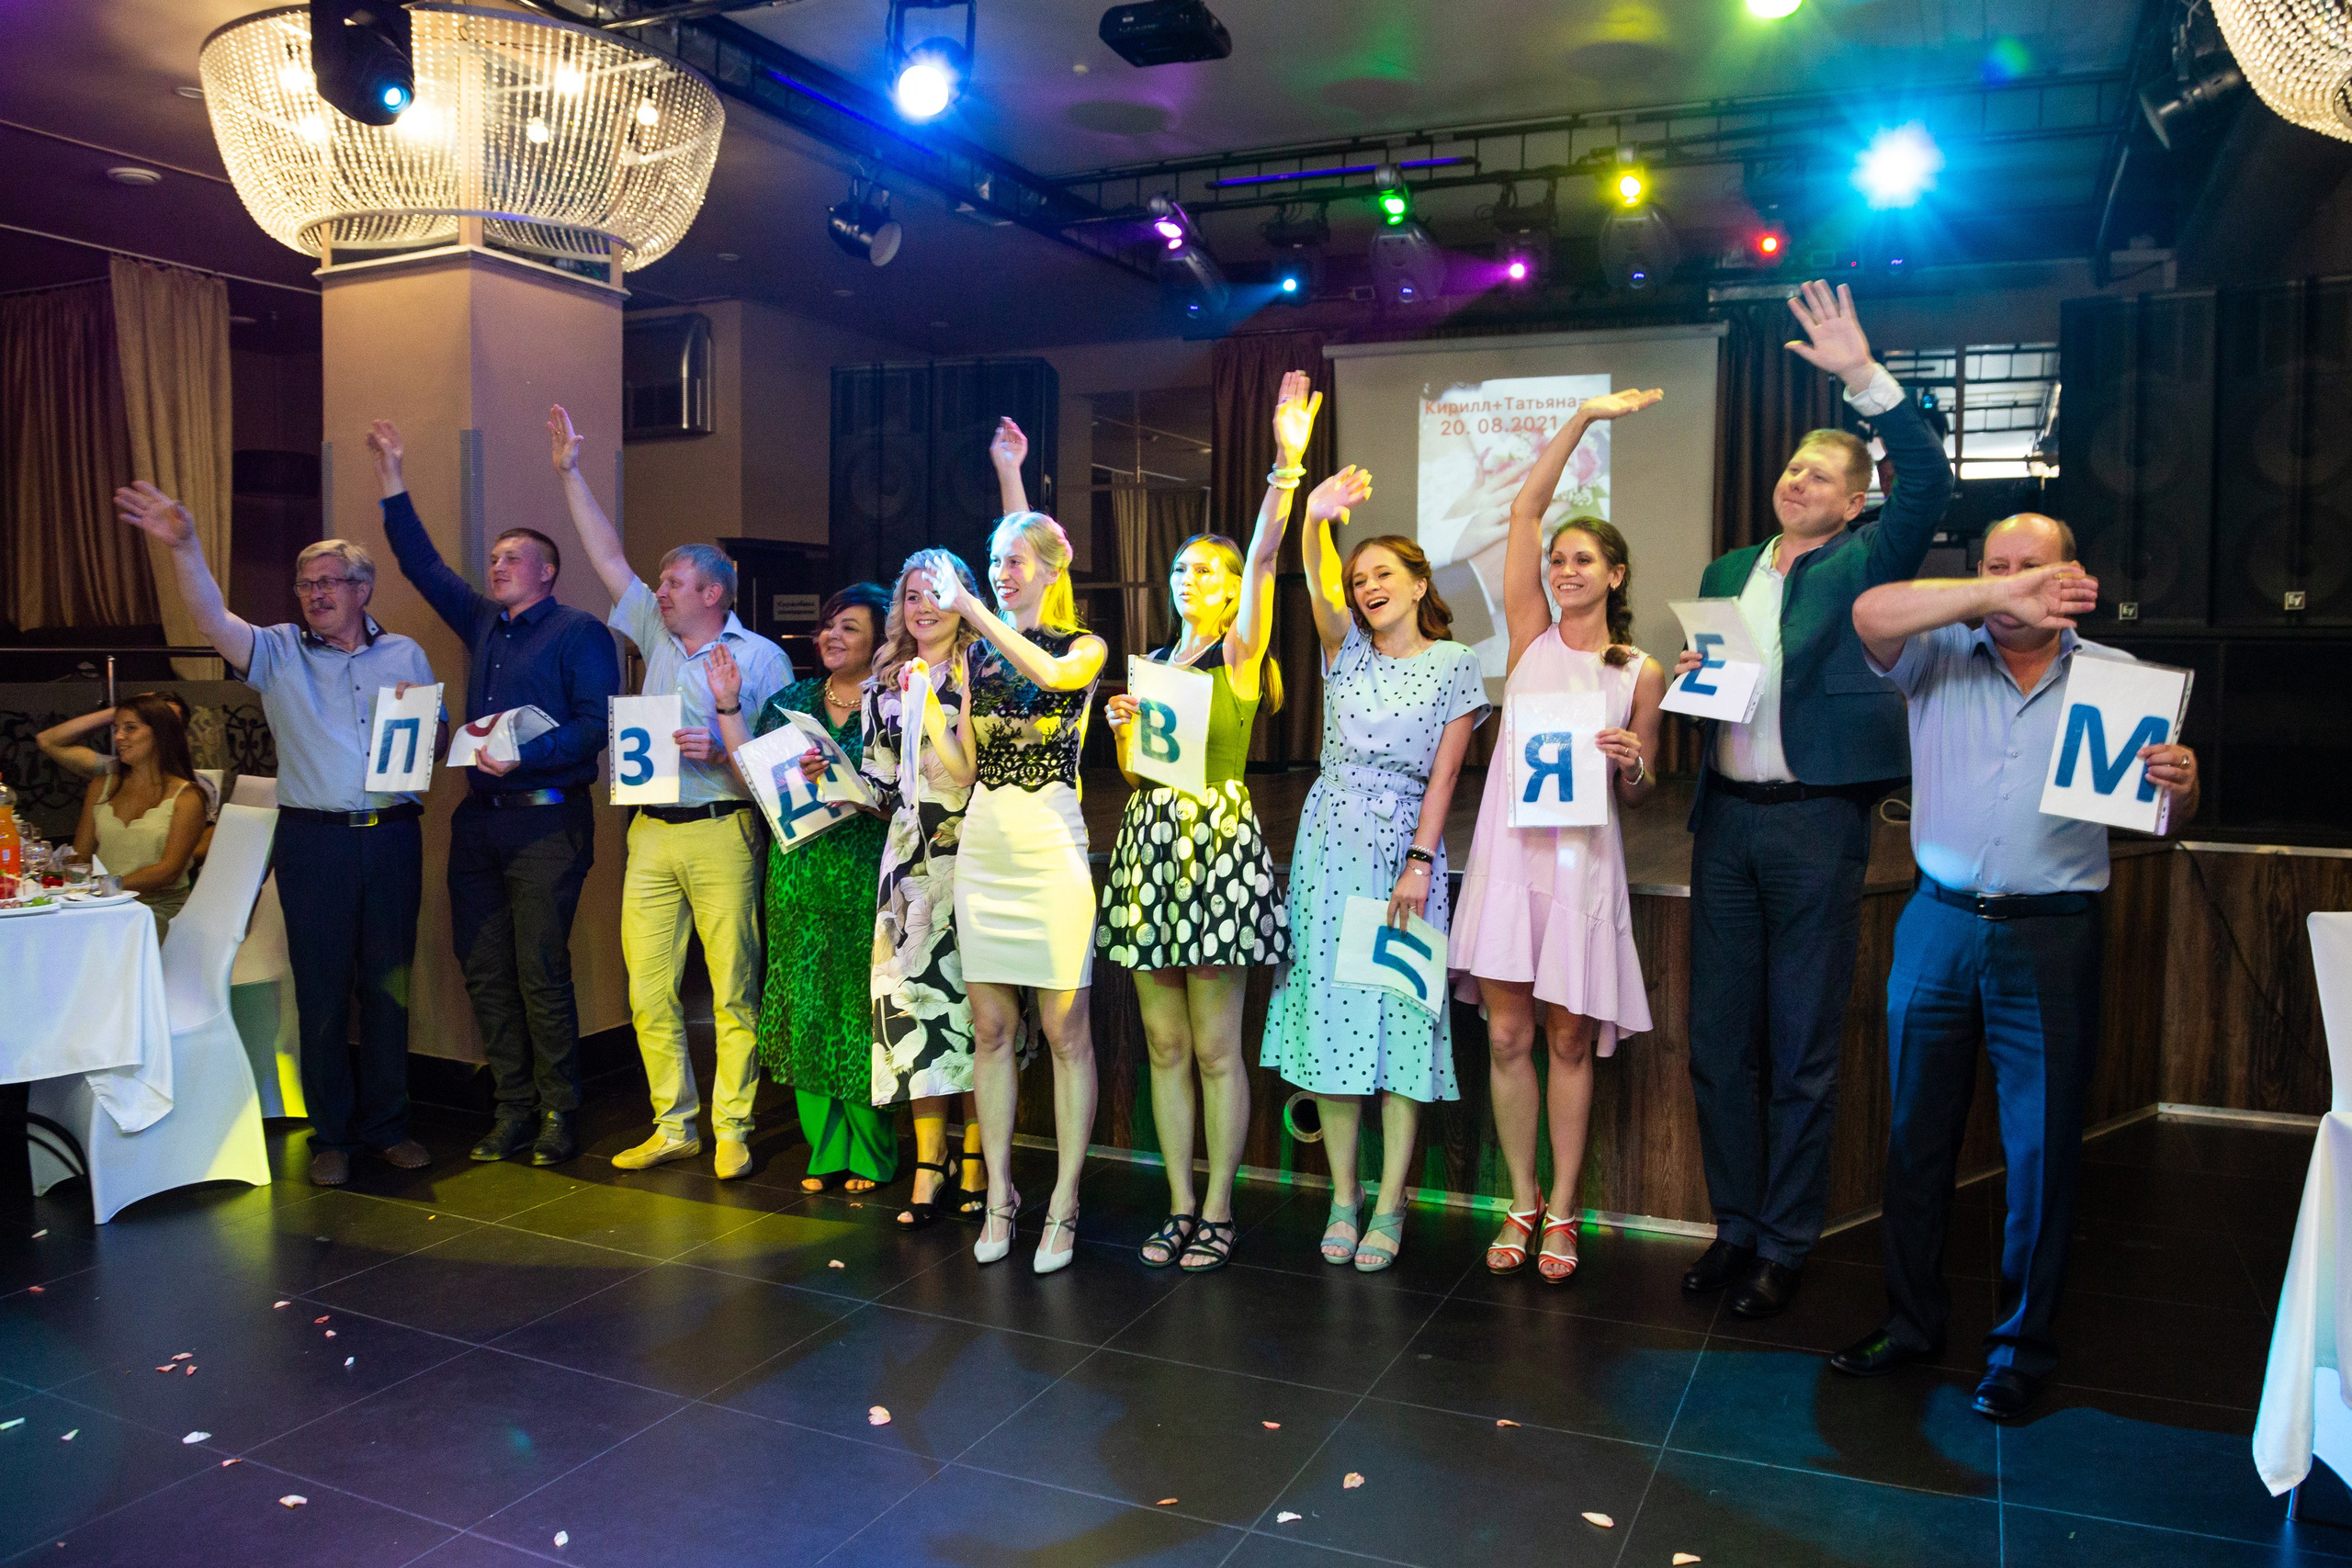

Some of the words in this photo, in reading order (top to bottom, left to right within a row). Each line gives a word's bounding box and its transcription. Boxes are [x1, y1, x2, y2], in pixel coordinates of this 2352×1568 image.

[1441, 420, 1470, 436] 20.
[1477, 415, 1558, 434] 08.2021
[377, 717, 421, 774] П
[1138, 697, 1182, 763] В
[2053, 703, 2171, 804] М
[770, 752, 842, 840] Д
[1522, 731, 1574, 803] Я
